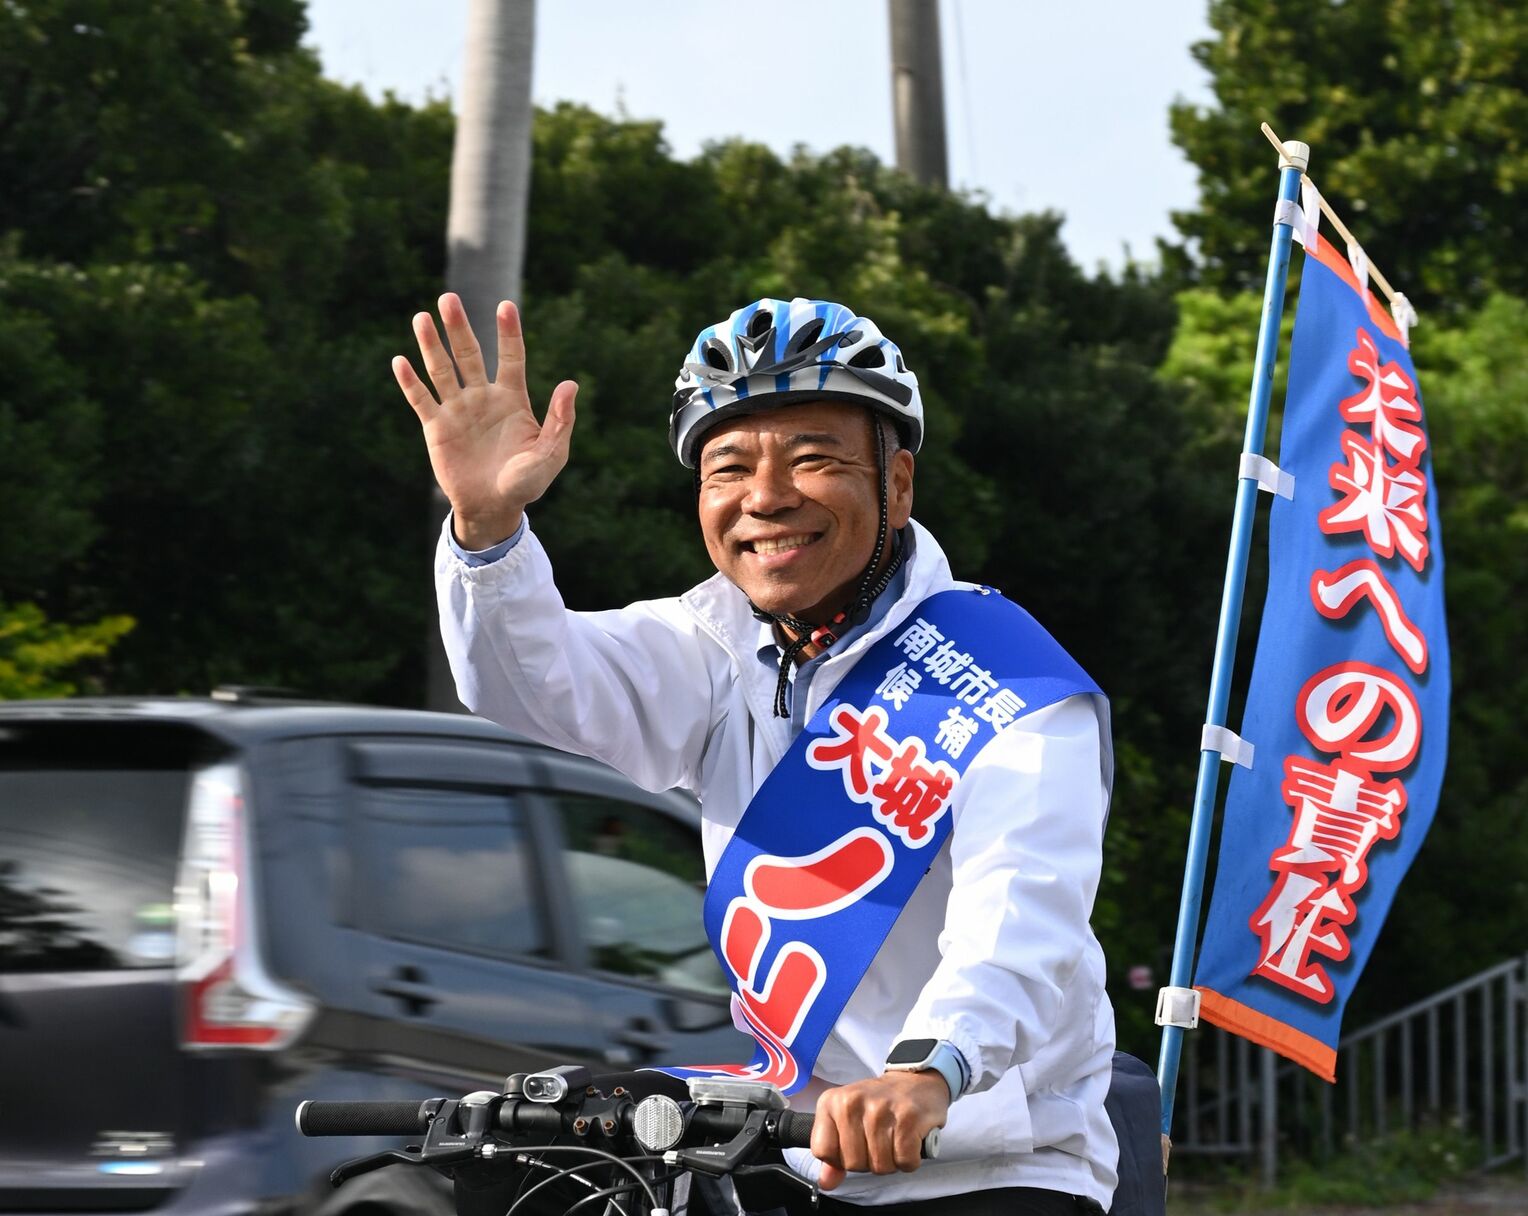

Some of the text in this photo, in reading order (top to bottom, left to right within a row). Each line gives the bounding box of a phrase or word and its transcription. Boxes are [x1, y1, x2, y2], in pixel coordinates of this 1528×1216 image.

[894, 617, 1027, 733] 南城市長
[1249, 326, 1430, 1004] 未来への責任
[805, 703, 959, 849] 大城
